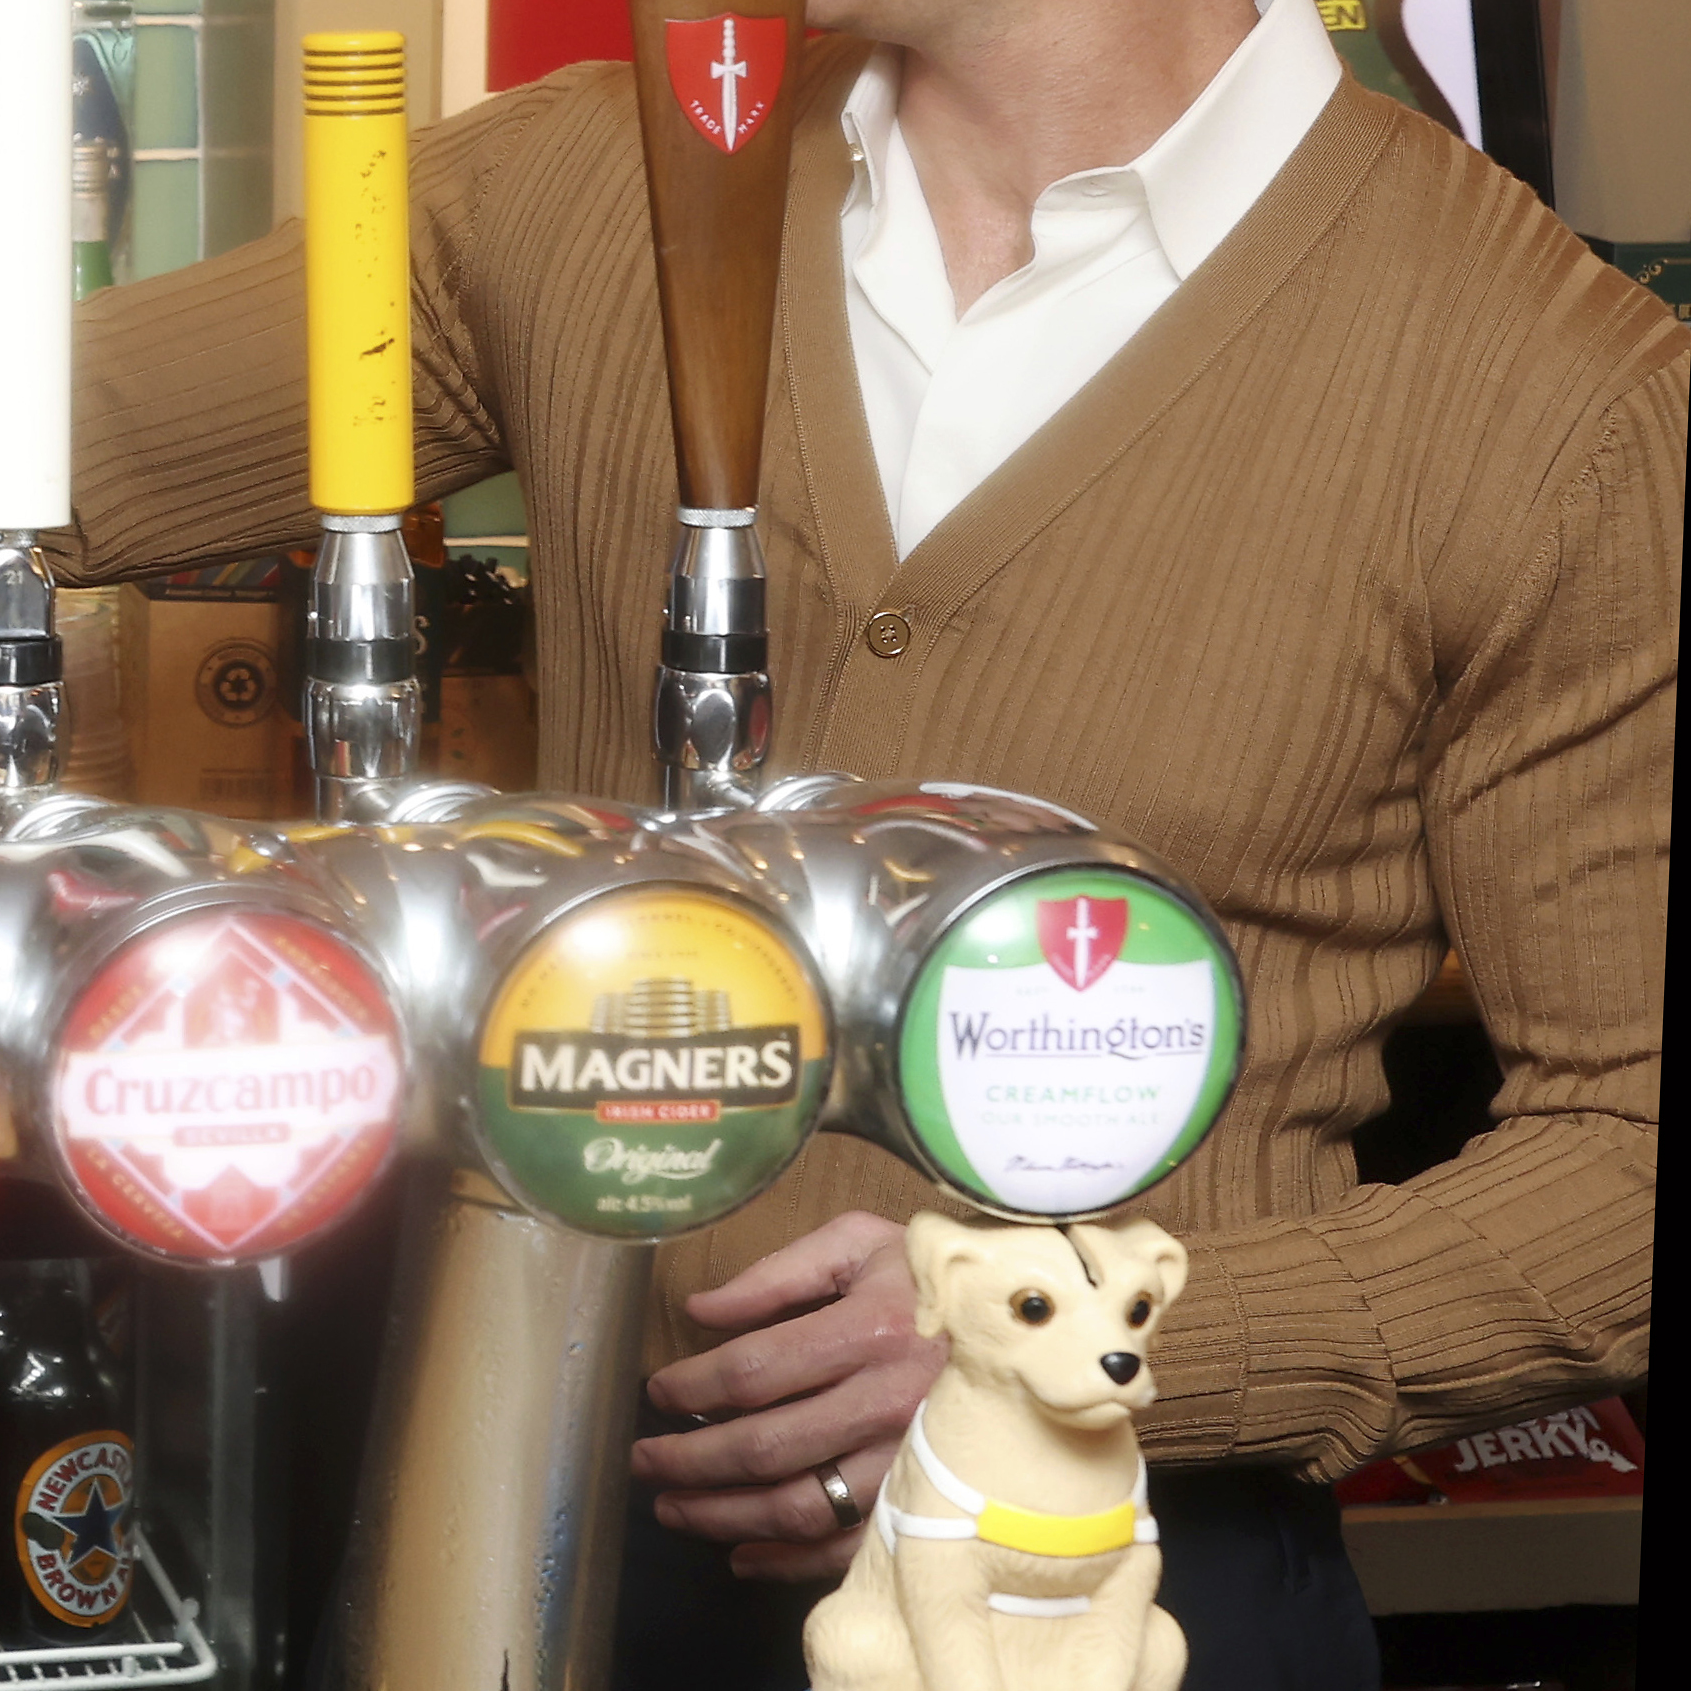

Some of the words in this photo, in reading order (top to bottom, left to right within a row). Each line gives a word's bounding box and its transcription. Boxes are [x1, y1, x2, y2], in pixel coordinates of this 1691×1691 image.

[690, 99, 723, 135] TRADE
[737, 100, 765, 135] MARK
[948, 1010, 1206, 1061] Worthington's
[84, 1061, 379, 1119] Cruzcampo
[521, 1039, 794, 1093] MAGNERS
[986, 1084, 1163, 1106] CREAMFLOW
[583, 1137, 723, 1186] Original
[1454, 1420, 1591, 1472] JERKY
[35, 1554, 119, 1610] BROWN
